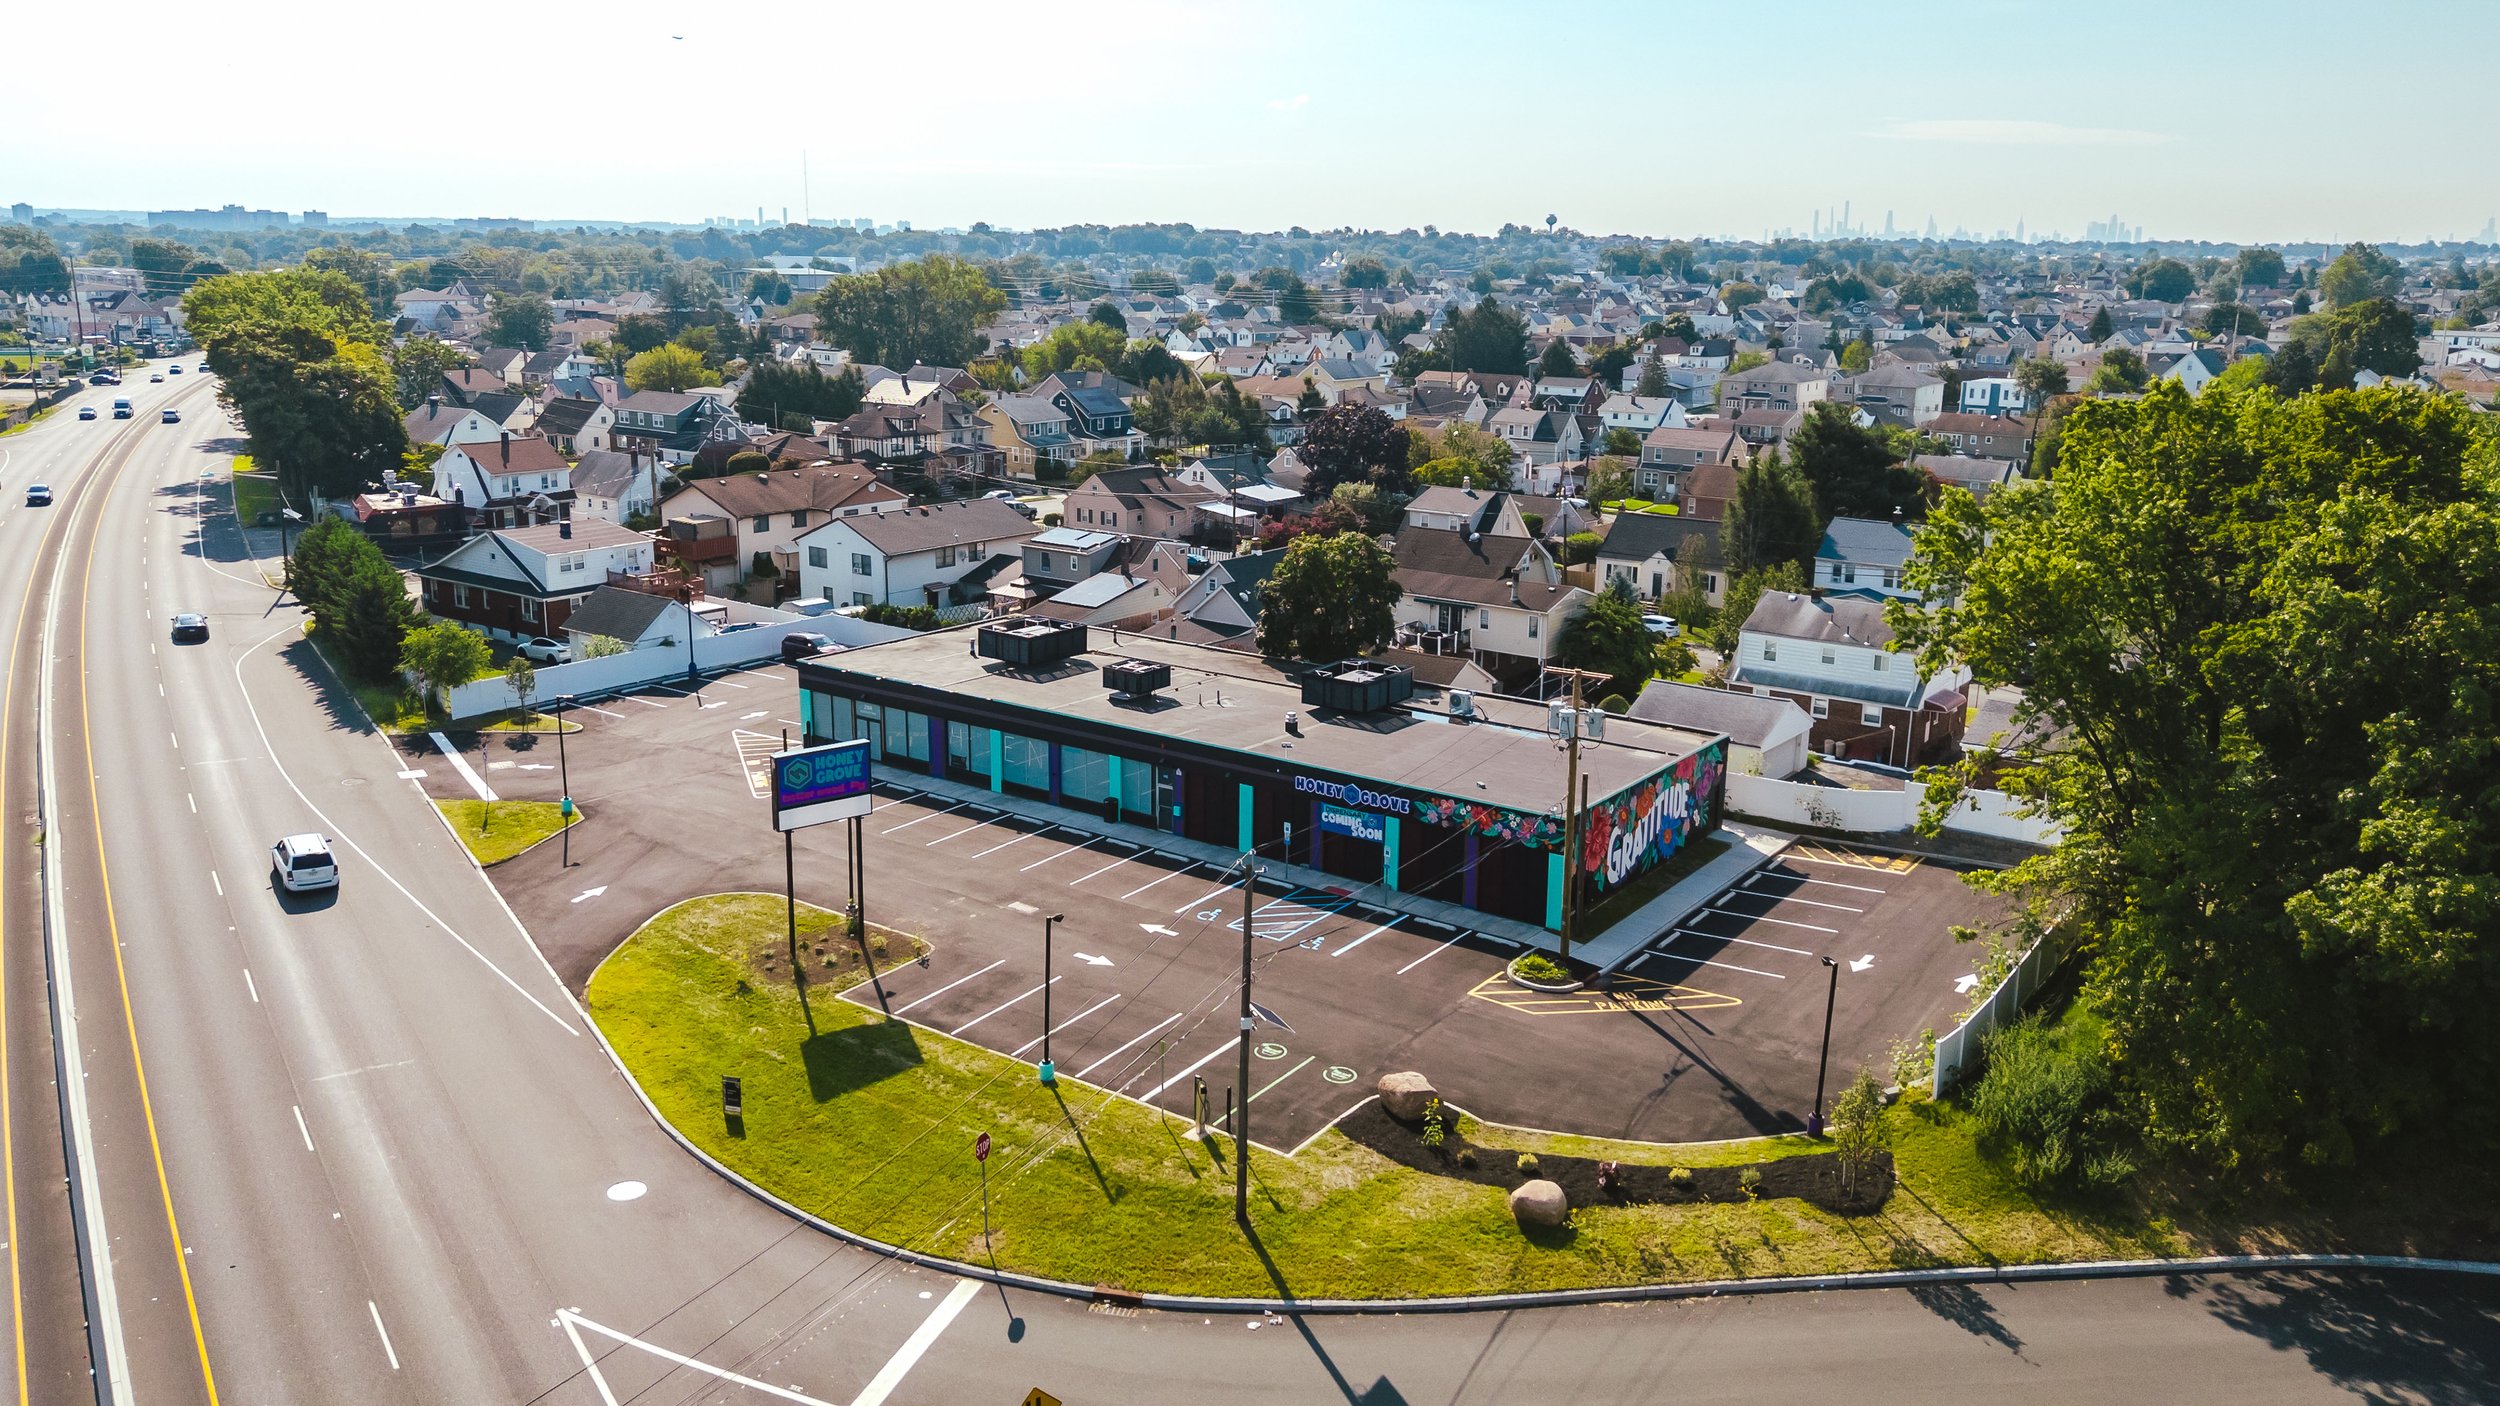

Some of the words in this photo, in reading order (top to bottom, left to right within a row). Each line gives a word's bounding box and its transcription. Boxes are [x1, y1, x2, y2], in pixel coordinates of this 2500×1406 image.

[815, 749, 864, 770] HONEY
[816, 764, 862, 784] GROVE
[1295, 776, 1344, 799] HONEY
[1361, 790, 1410, 814] GROVE
[1321, 811, 1362, 827] COMING
[1351, 824, 1383, 841] SOON
[1612, 991, 1638, 1000] NO
[1594, 999, 1673, 1011] PARKING
[976, 1138, 990, 1156] STOP
